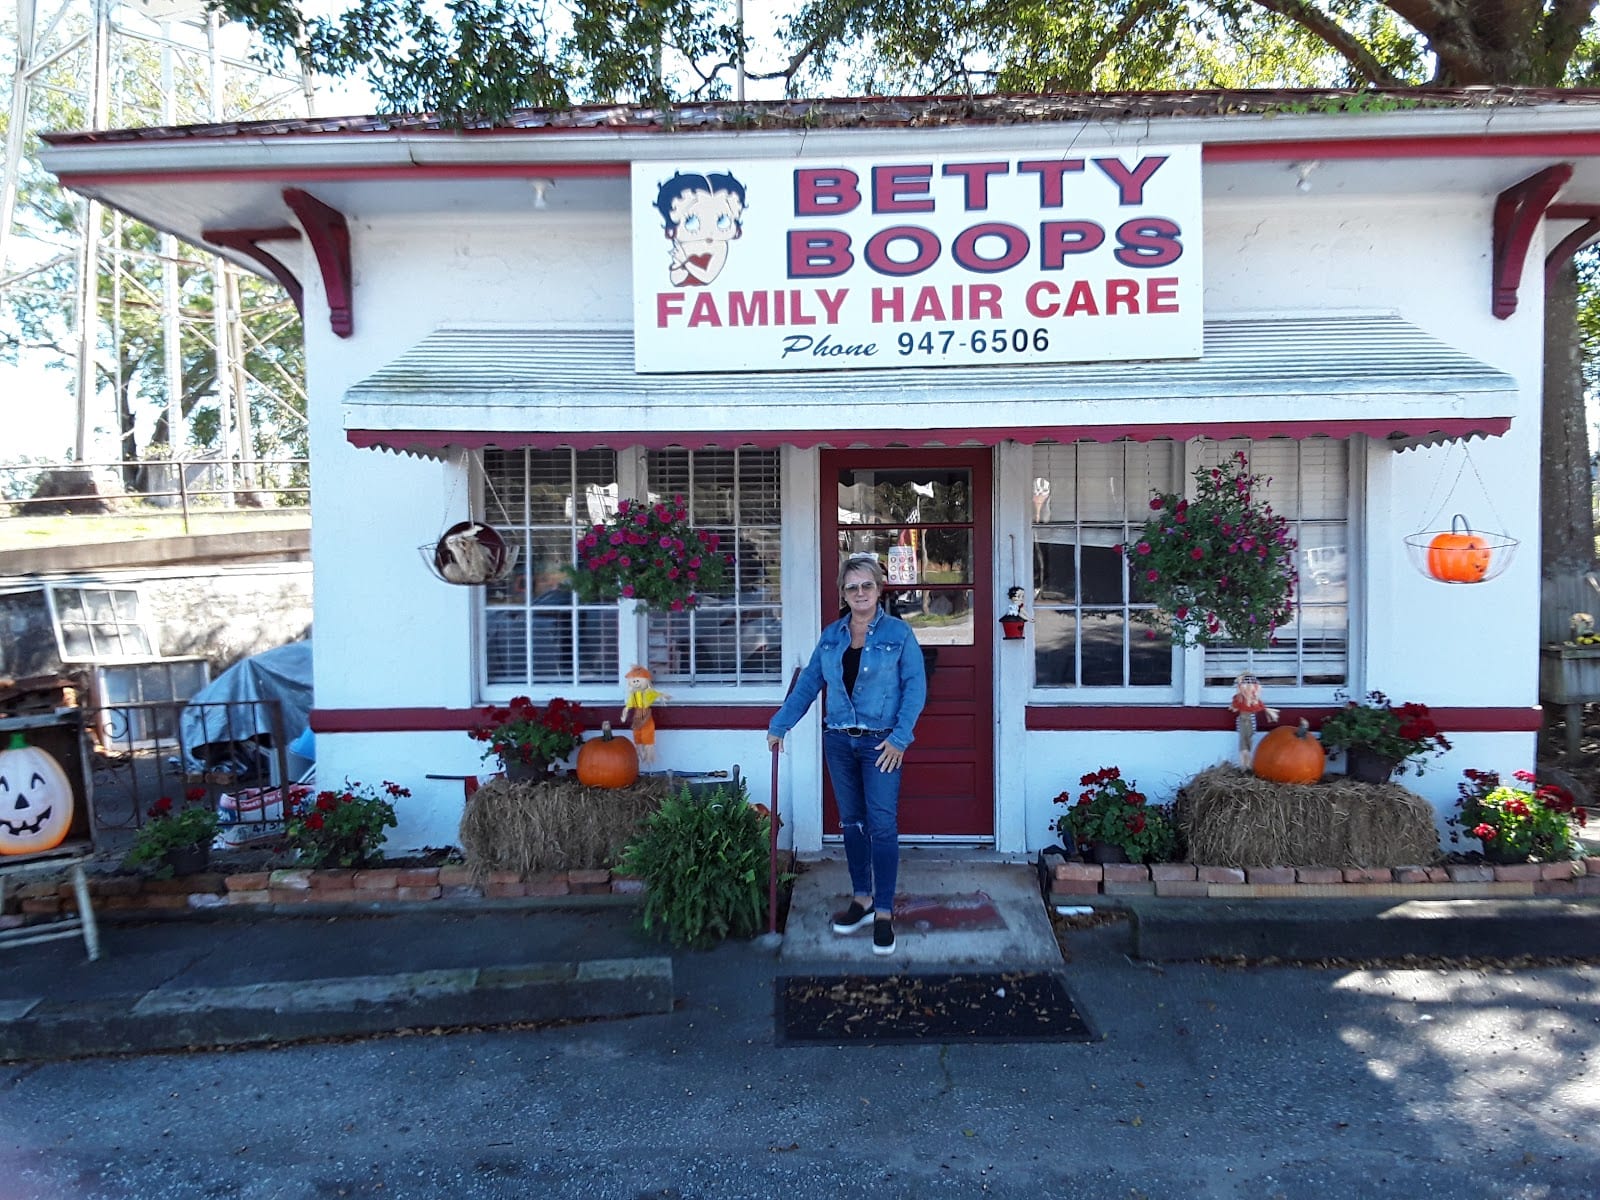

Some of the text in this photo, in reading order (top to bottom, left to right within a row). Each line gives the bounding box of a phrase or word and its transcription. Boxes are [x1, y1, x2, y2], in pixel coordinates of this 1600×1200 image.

[794, 155, 1170, 217] BETTY
[786, 218, 1183, 280] BOOPS
[656, 278, 1180, 328] FAMILY HAIR CARE
[781, 328, 1050, 360] Phone 947-6506
